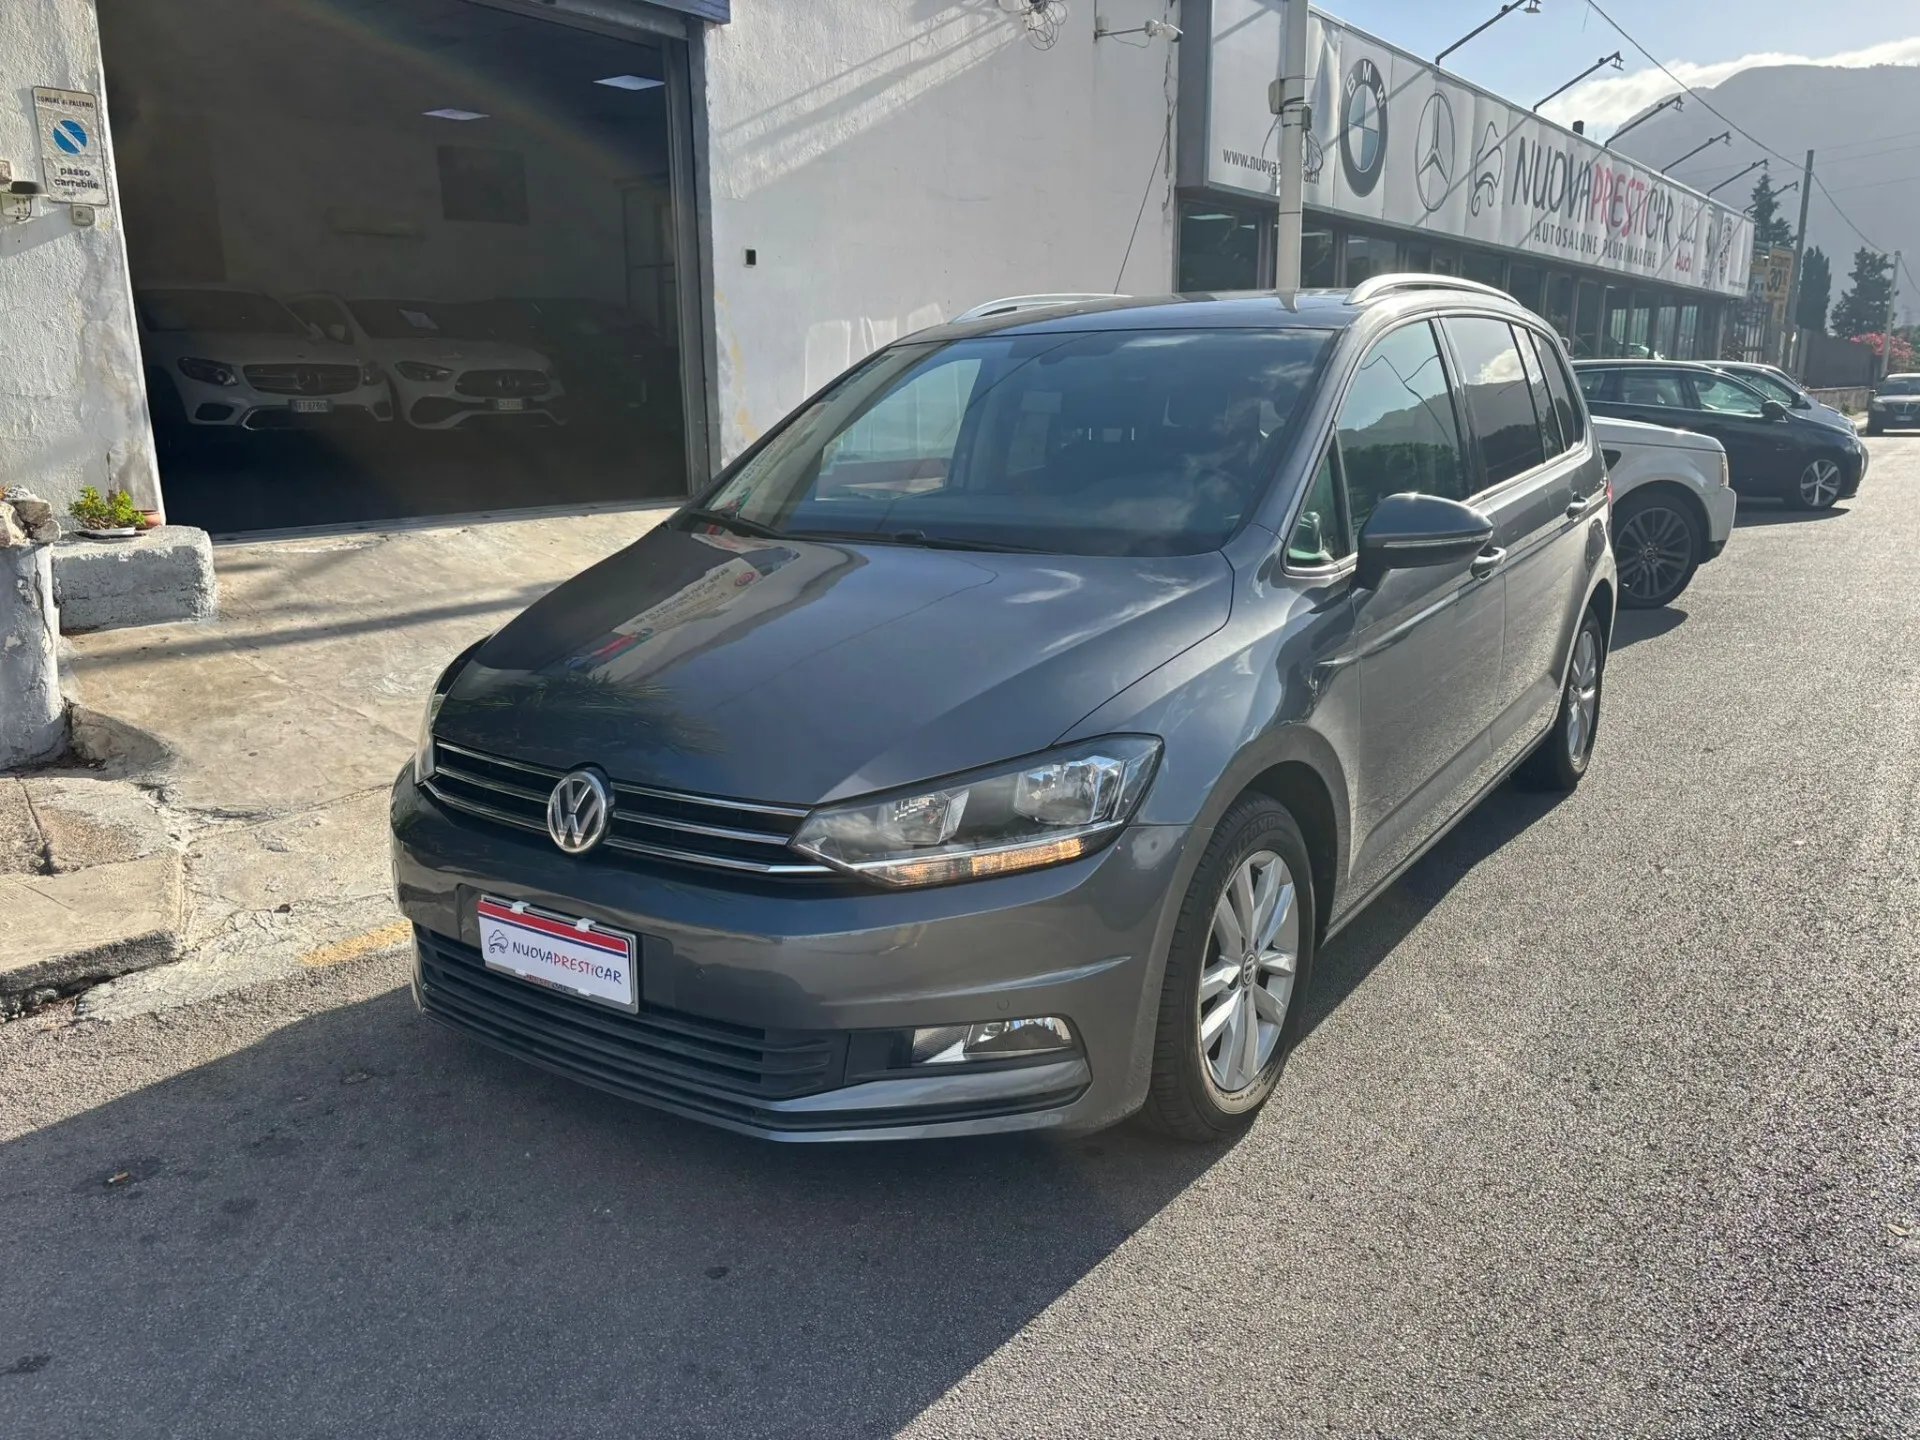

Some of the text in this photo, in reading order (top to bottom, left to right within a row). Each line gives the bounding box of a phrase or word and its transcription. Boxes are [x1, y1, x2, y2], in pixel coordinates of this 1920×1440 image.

[1346, 60, 1386, 107] BMW
[60, 167, 91, 177] passo
[54, 178, 99, 190] carrabile
[1534, 221, 1597, 255] AUTOSALONE
